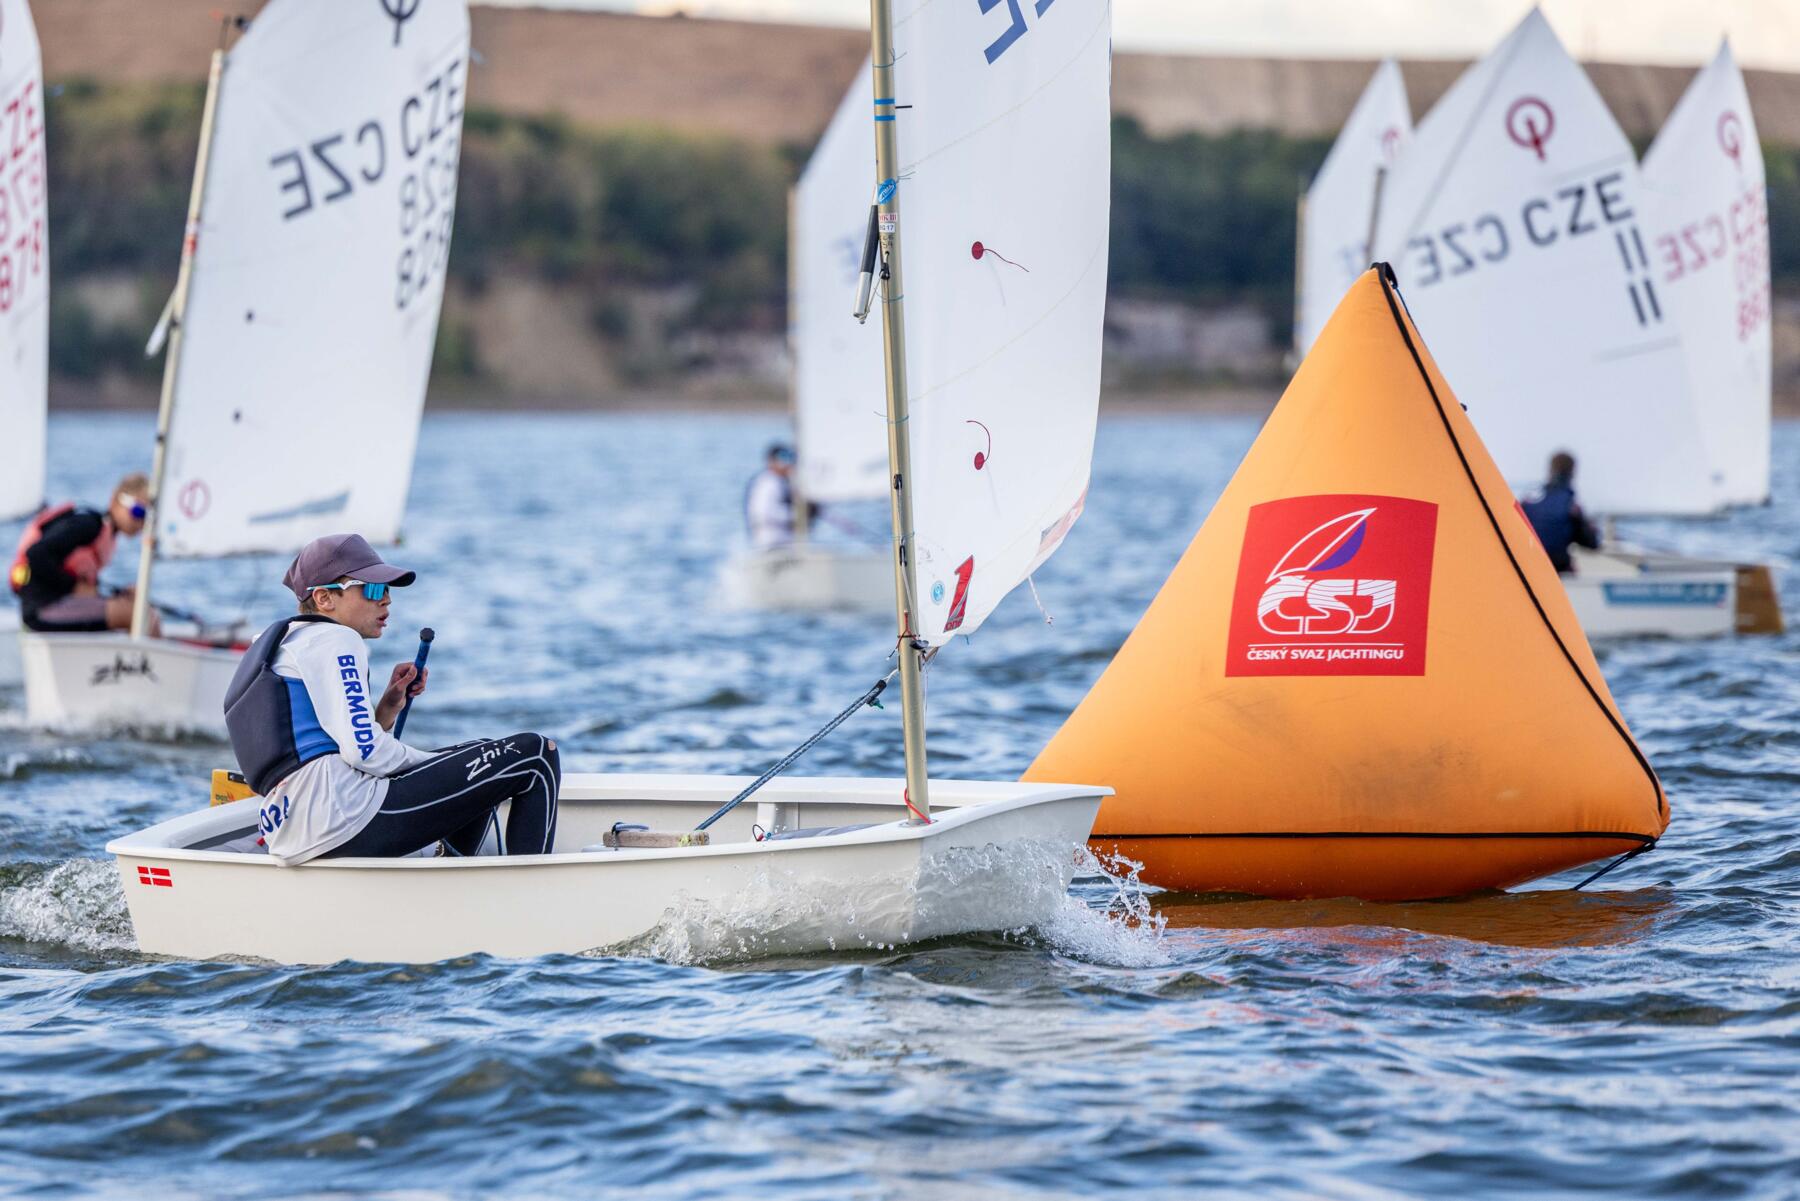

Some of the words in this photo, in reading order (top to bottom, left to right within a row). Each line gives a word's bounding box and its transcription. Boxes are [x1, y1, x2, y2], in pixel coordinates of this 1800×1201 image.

[0, 80, 43, 172] ZE
[400, 60, 463, 158] CZE
[1522, 171, 1635, 247] CZE
[1628, 276, 1663, 328] 11
[1247, 646, 1289, 661] ČESKÝ
[1290, 648, 1325, 660] SVAZ
[1327, 648, 1404, 662] JACHTINGU
[337, 654, 377, 761] BERMUDA
[260, 795, 289, 836] 02
